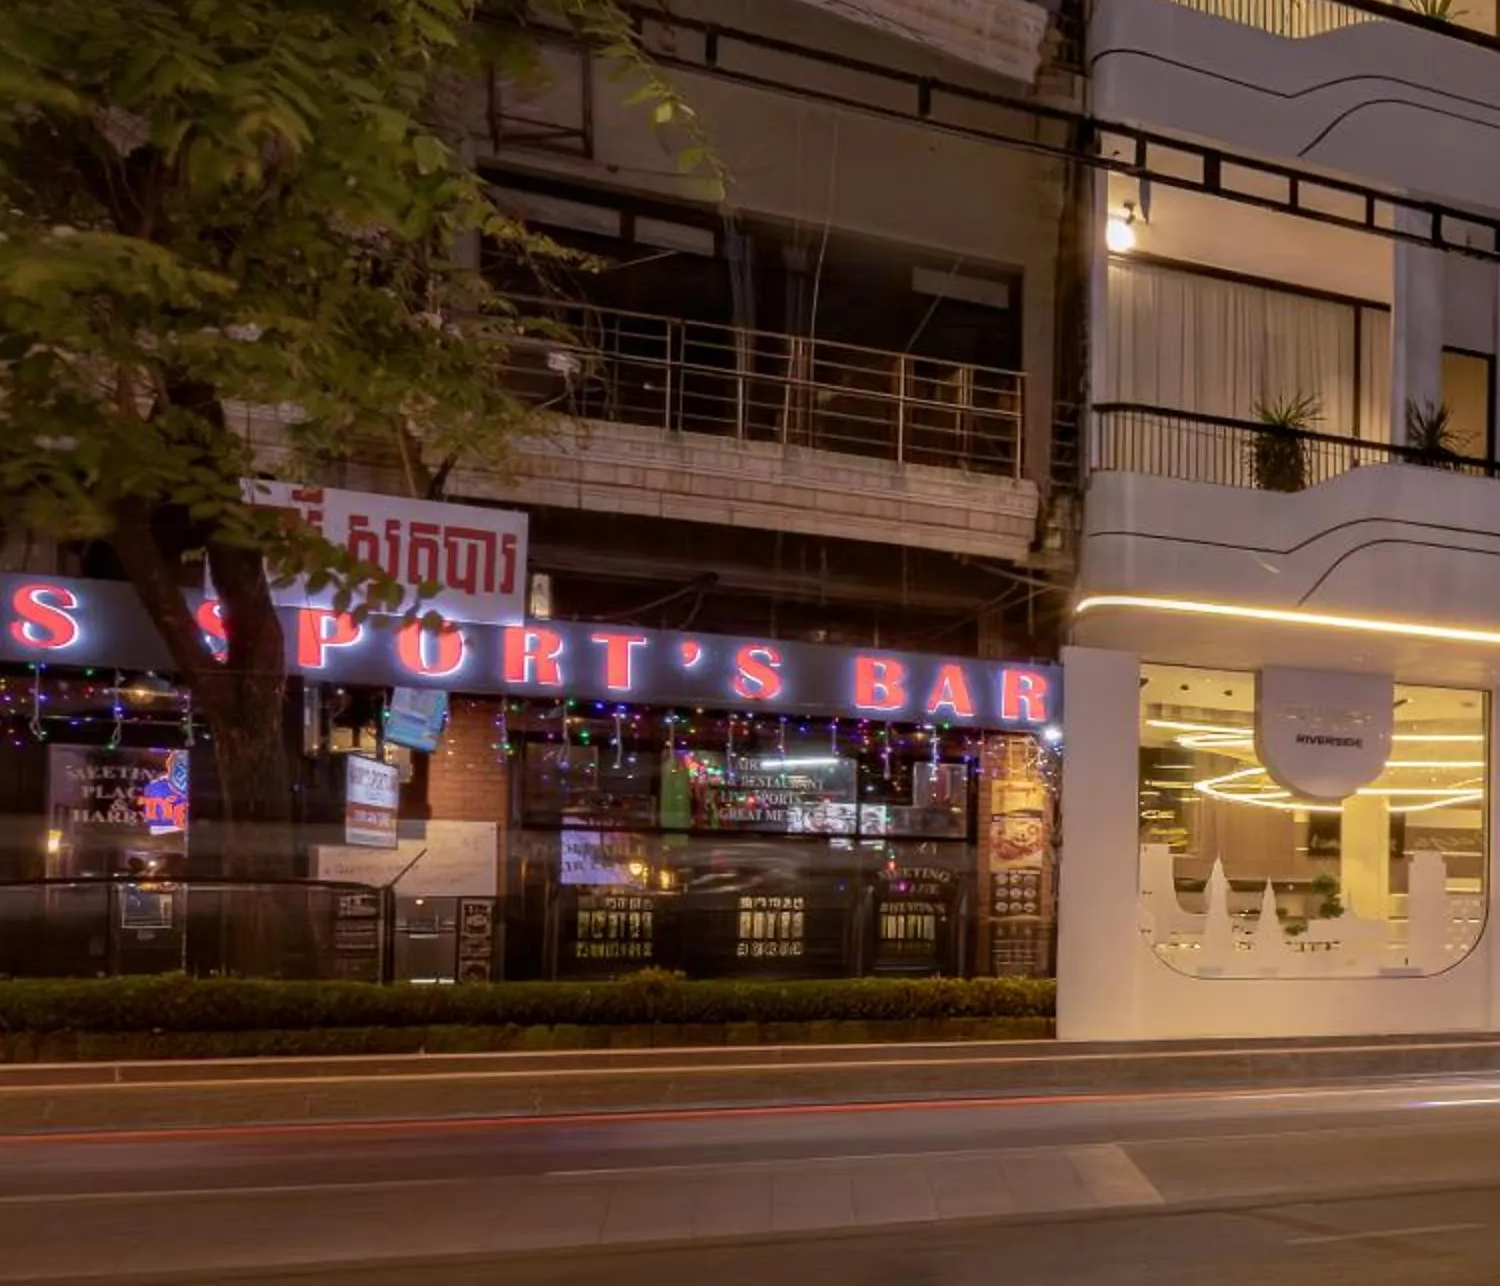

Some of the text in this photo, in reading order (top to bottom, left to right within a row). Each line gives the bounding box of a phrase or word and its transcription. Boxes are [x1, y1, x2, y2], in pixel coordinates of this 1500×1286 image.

[854, 656, 1050, 722] BAR
[1296, 733, 1364, 749] RIVERSIDE
[66, 765, 157, 780] MEETIN
[81, 785, 145, 800] PLAC
